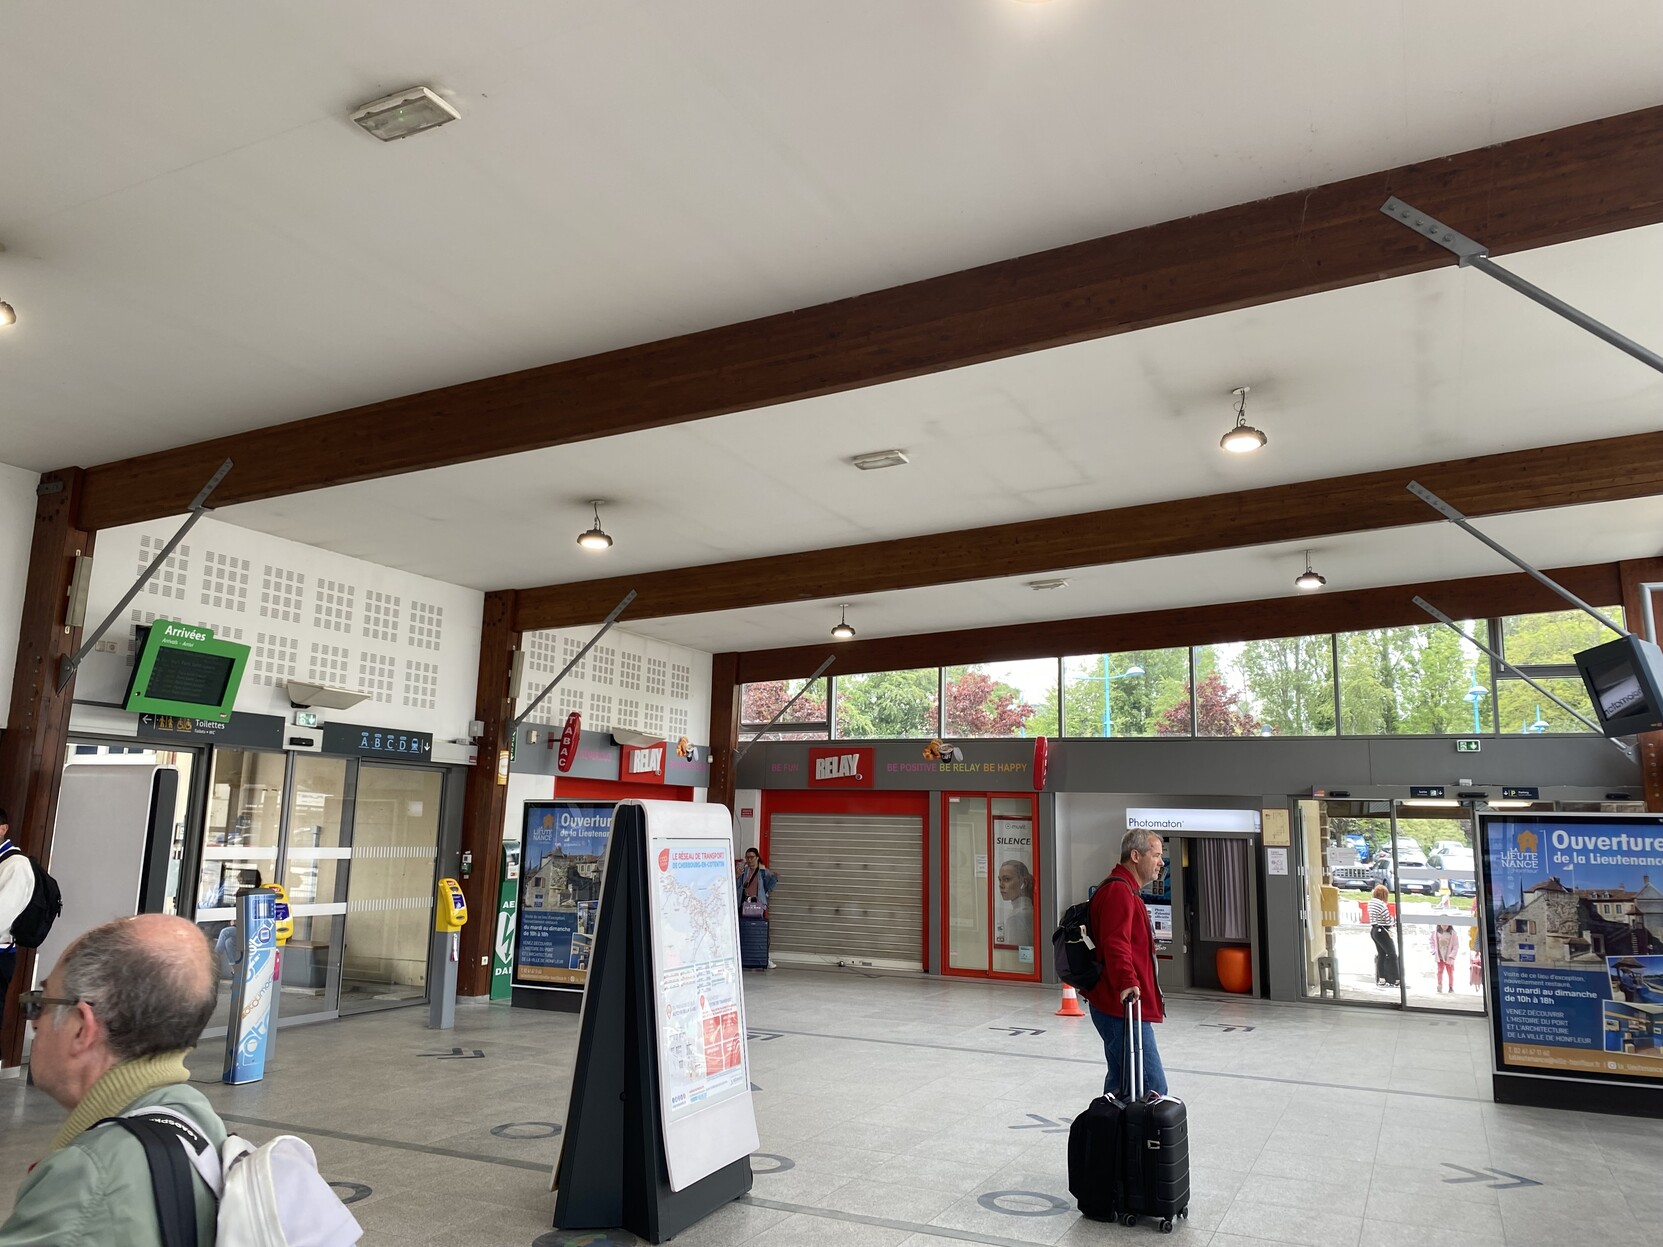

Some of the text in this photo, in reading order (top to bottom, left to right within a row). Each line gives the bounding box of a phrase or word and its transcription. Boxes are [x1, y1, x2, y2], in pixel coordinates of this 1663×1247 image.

[164, 625, 207, 641] Arrivées
[195, 719, 225, 730] Toilettes
[360, 736, 407, 750] A B C D
[558, 715, 576, 767] TABAC
[630, 748, 663, 773] RELAY
[771, 763, 799, 772] BE FUN
[815, 753, 860, 780] RELAY
[887, 763, 1027, 772] BE POSITIVE BE RELAY BE HAPPY
[1128, 818, 1183, 828] Photomaton
[996, 837, 1032, 846] SILENCE
[1552, 830, 1663, 852] Ouverture
[1500, 851, 1539, 861] LIEUTE
[1553, 851, 1570, 863] de
[1573, 852, 1586, 864] la
[1500, 860, 1539, 869] NANCE
[1504, 985, 1598, 999] du mardi au dimanche
[1517, 995, 1531, 1003] 10h
[1532, 996, 1539, 1004] à
[1540, 996, 1555, 1005] 18h
[1505, 1008, 1527, 1016] VENEZ
[1552, 1019, 1569, 1027] PORT
[1526, 1033, 1544, 1041] VILLE
[1545, 1034, 1555, 1042] DE
[1555, 1035, 1592, 1044] HONFLEUR
